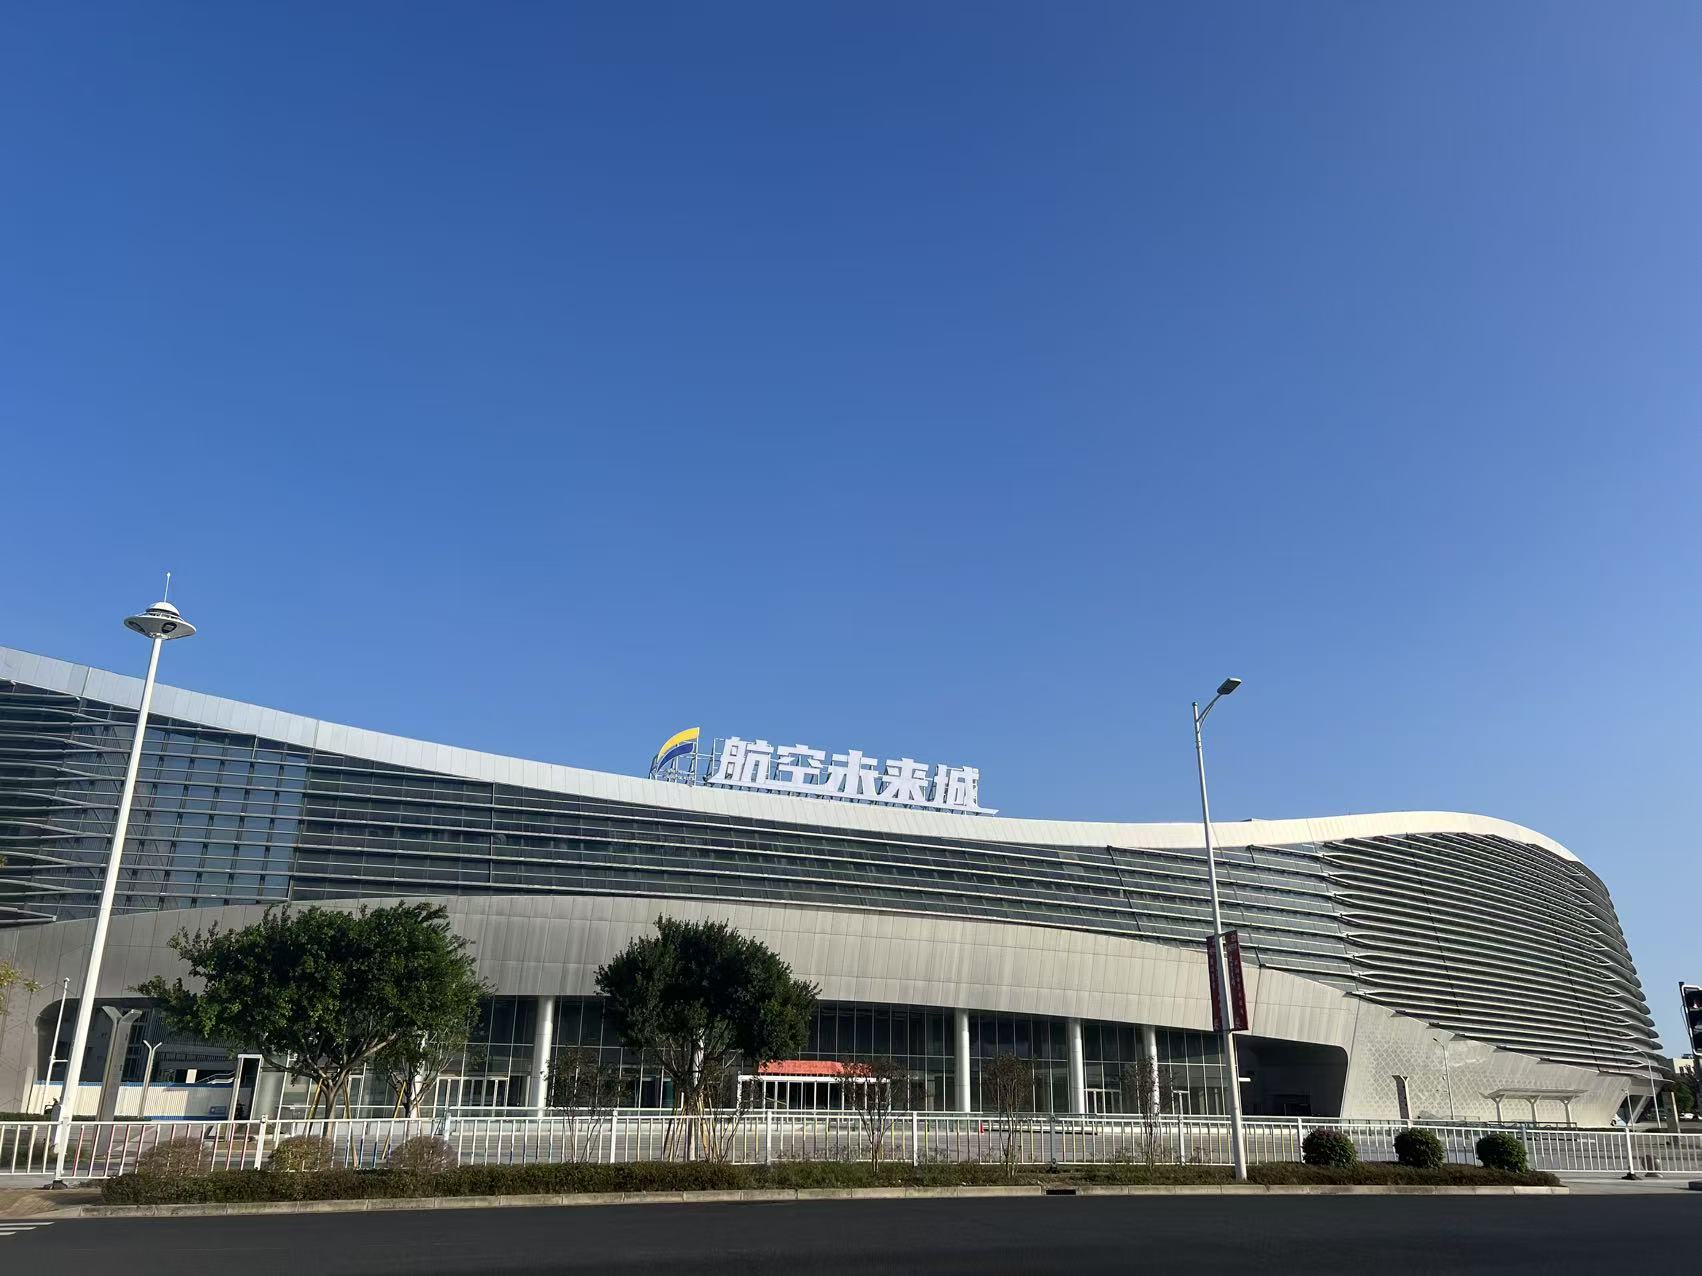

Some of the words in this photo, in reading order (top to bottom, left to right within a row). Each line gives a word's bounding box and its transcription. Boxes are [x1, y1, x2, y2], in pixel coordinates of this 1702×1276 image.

[707, 736, 999, 814] 航空未来城
